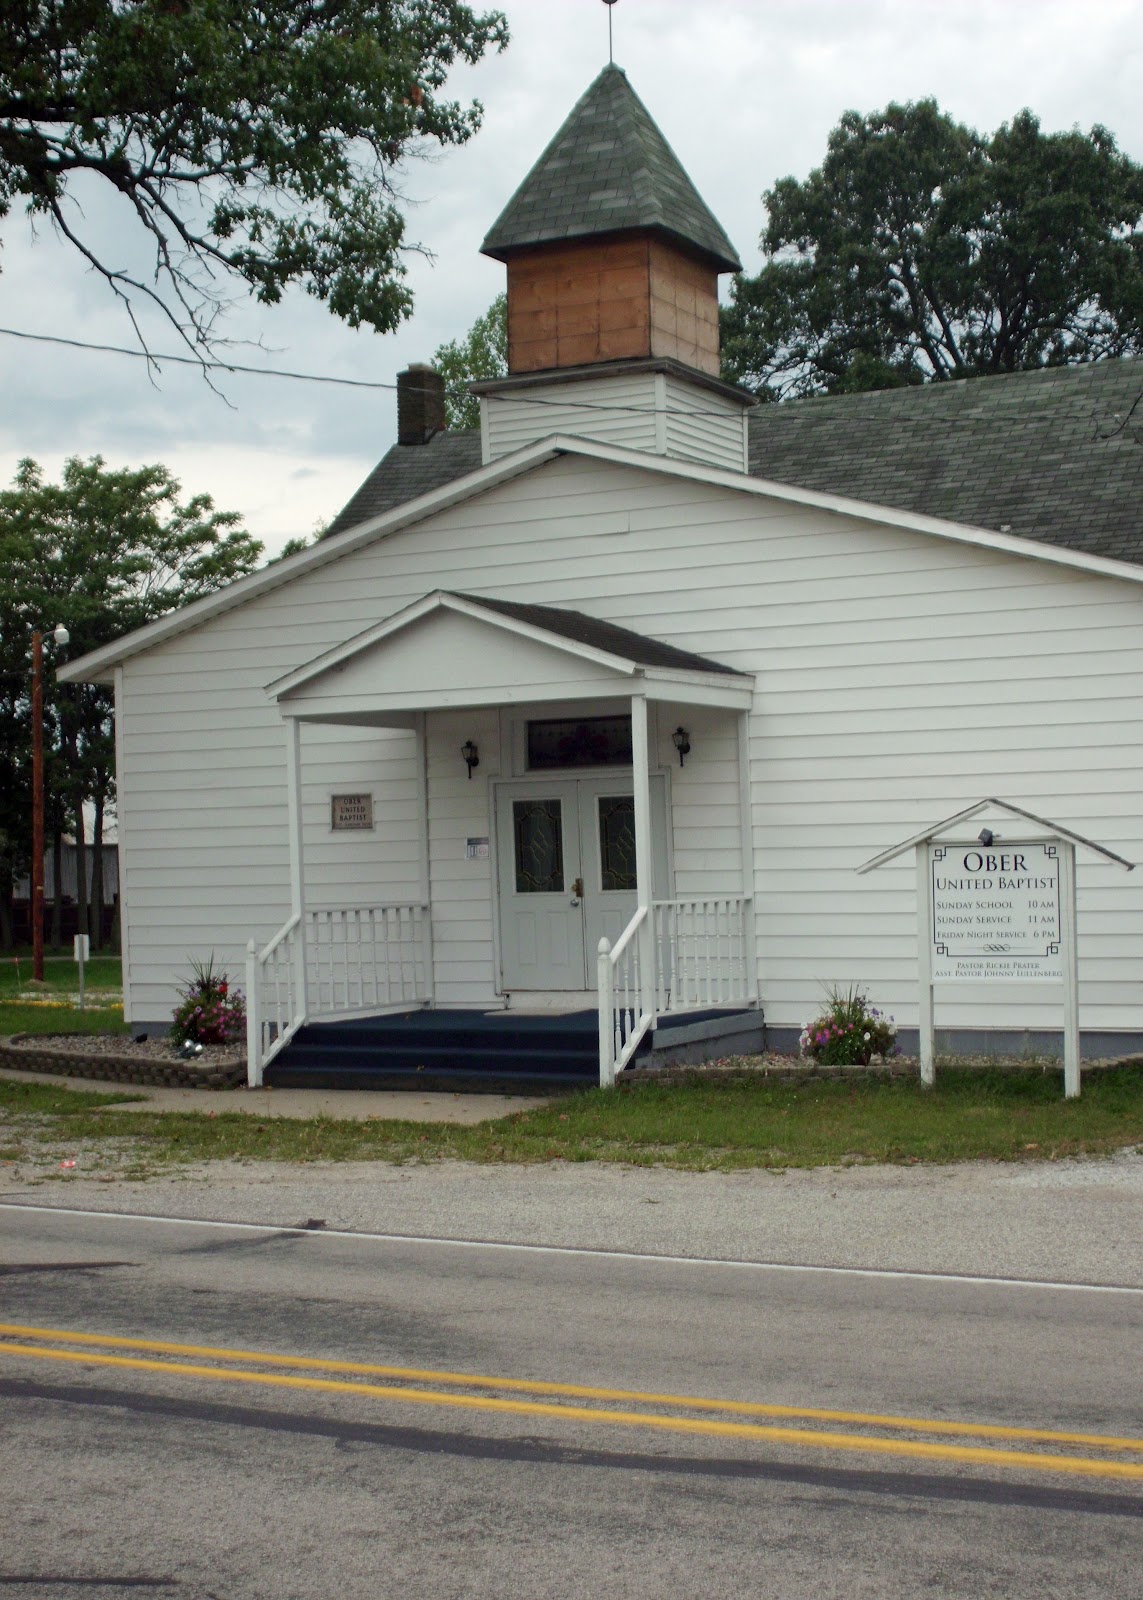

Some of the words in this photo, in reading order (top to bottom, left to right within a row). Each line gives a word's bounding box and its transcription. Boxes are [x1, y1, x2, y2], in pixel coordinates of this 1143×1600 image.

[963, 852, 1028, 872] OBER
[936, 878, 993, 890] UNITED
[998, 877, 1056, 889] BAPTIST
[936, 901, 973, 910] SUNDAY
[975, 900, 1014, 909] SCHOOL
[1028, 899, 1038, 909] 10
[1039, 900, 1055, 909] AM
[936, 915, 973, 924] SUNDAY
[976, 915, 1012, 924] SERVICE
[1028, 915, 1038, 923] 11
[1040, 914, 1055, 923] AM
[937, 930, 965, 939] FRIDAY
[966, 930, 993, 938] NIGHT
[996, 930, 1027, 938] SERVICE
[1033, 930, 1040, 938] 6
[1042, 930, 1056, 938] PM
[957, 961, 985, 969] PASTOR
[986, 961, 1011, 969] RICKIE
[1013, 961, 1040, 969] PRATER
[983, 970, 1015, 978] JOHNNY
